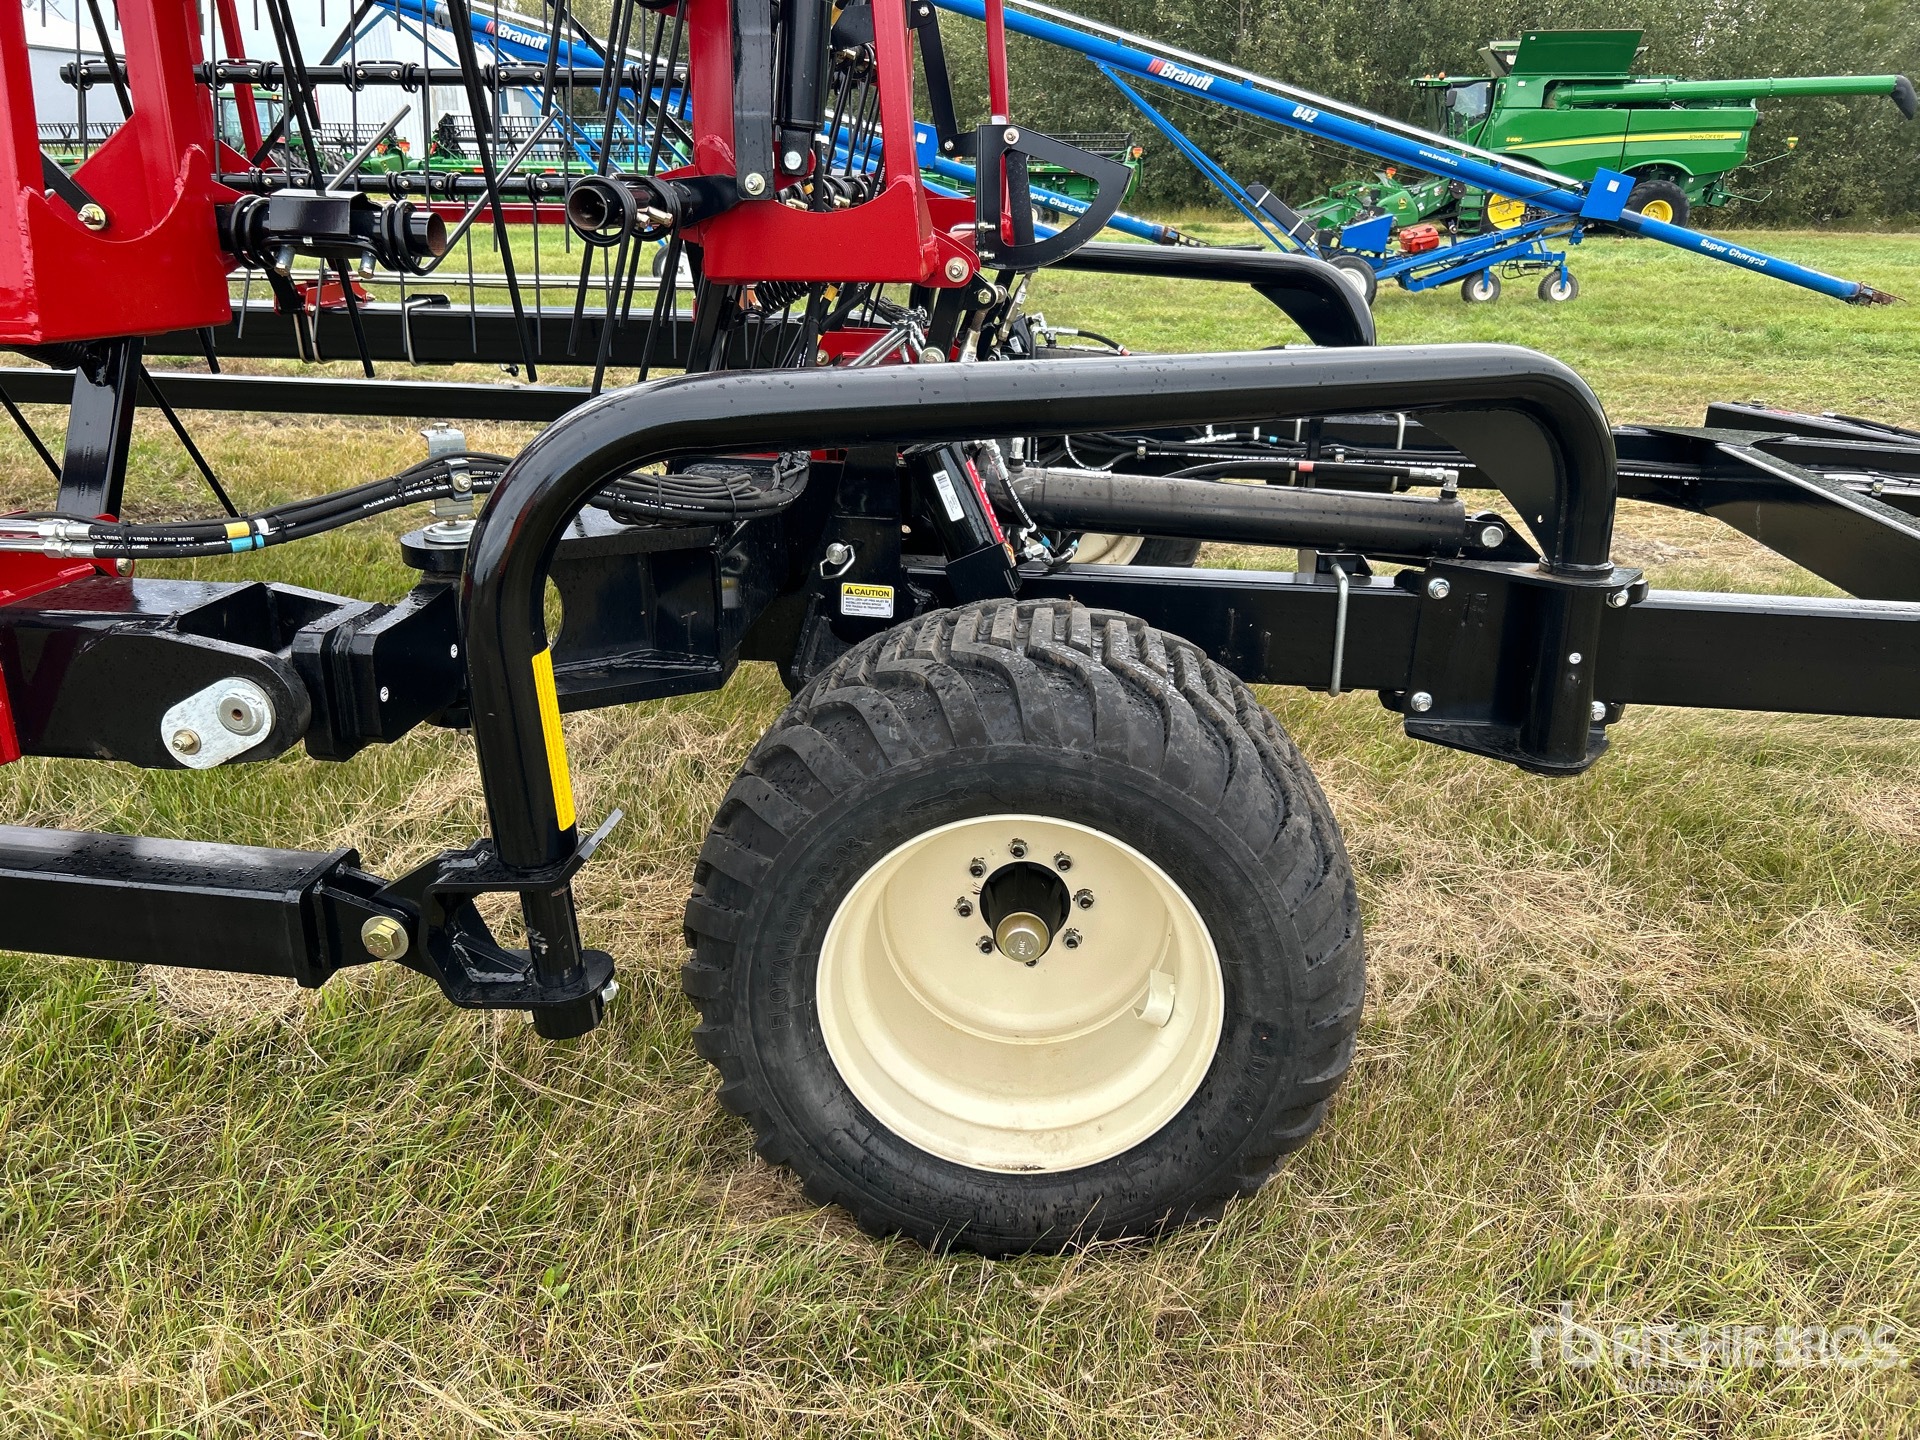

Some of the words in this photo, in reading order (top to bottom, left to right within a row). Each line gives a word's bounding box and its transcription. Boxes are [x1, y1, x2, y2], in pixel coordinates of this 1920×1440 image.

[498, 24, 547, 50] Brandt
[1159, 62, 1215, 91] Brandt
[1292, 105, 1318, 123] 842
[1419, 149, 1458, 167] www.brandt.ca
[1030, 191, 1047, 204] uper
[1049, 197, 1086, 214] Charged
[1700, 238, 1727, 253] Super
[1729, 247, 1768, 267] Charged
[854, 588, 890, 598] CAUTION
[768, 902, 805, 1030] FLOTATION
[801, 836, 863, 903] TRC-03
